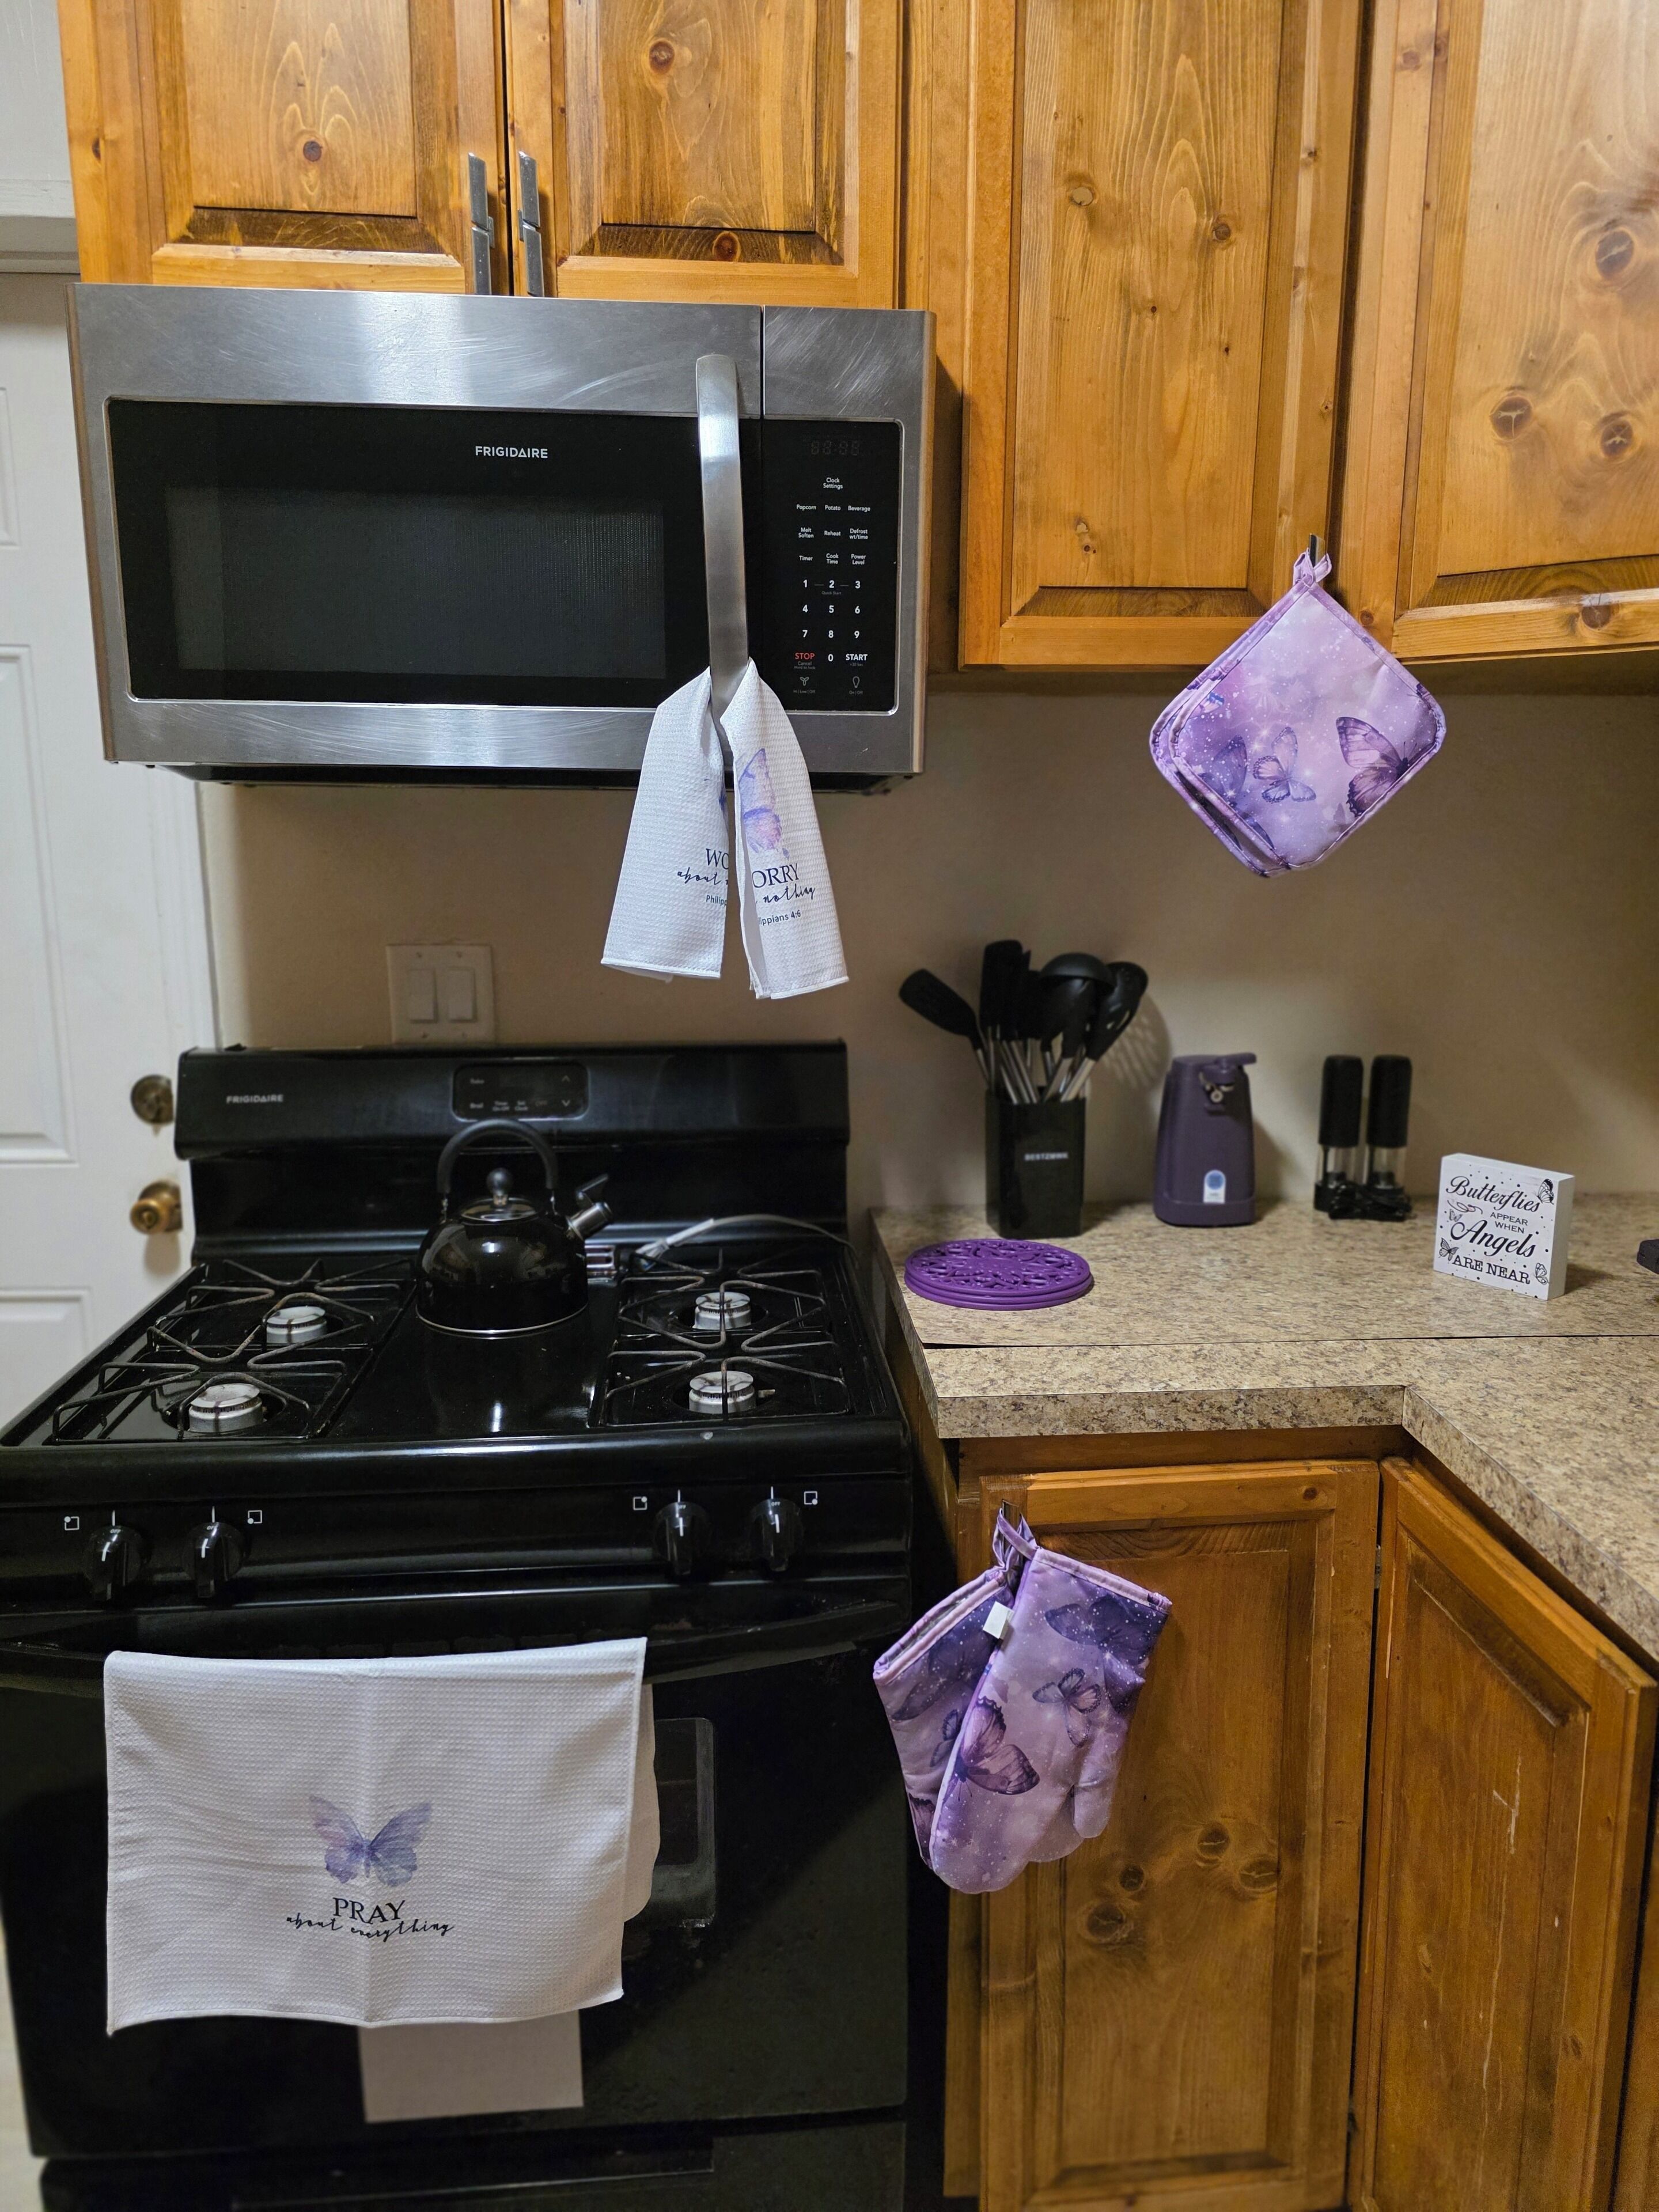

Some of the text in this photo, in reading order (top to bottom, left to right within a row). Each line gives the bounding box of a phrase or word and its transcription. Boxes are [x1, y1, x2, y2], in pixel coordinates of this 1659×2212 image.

[475, 446, 548, 459] FRIGIDAIRE
[803, 579, 808, 588] 1
[829, 579, 835, 589] 2
[855, 580, 861, 589] 3
[802, 604, 808, 613] 4
[828, 605, 835, 613] 5
[854, 605, 861, 614] 6
[802, 629, 808, 638] 7
[828, 630, 834, 638] 8
[854, 630, 860, 639] 9
[795, 652, 815, 660] STOP
[828, 653, 834, 662] 0
[677, 867, 722, 885] about
[763, 884, 816, 903] nothing
[790, 909, 801, 919] 4:6
[226, 1094, 283, 1104] FRIGIDAIRE
[1445, 1176, 1541, 1212] Butterflies
[1490, 1211, 1528, 1226] APPEAR
[1494, 1221, 1525, 1234] WHEN
[1450, 1219, 1536, 1257] Angels
[1452, 1255, 1531, 1285] ARE NEAR
[332, 1897, 406, 1925] PRAY
[286, 1912, 343, 1930] about
[350, 1919, 454, 1942] everything
